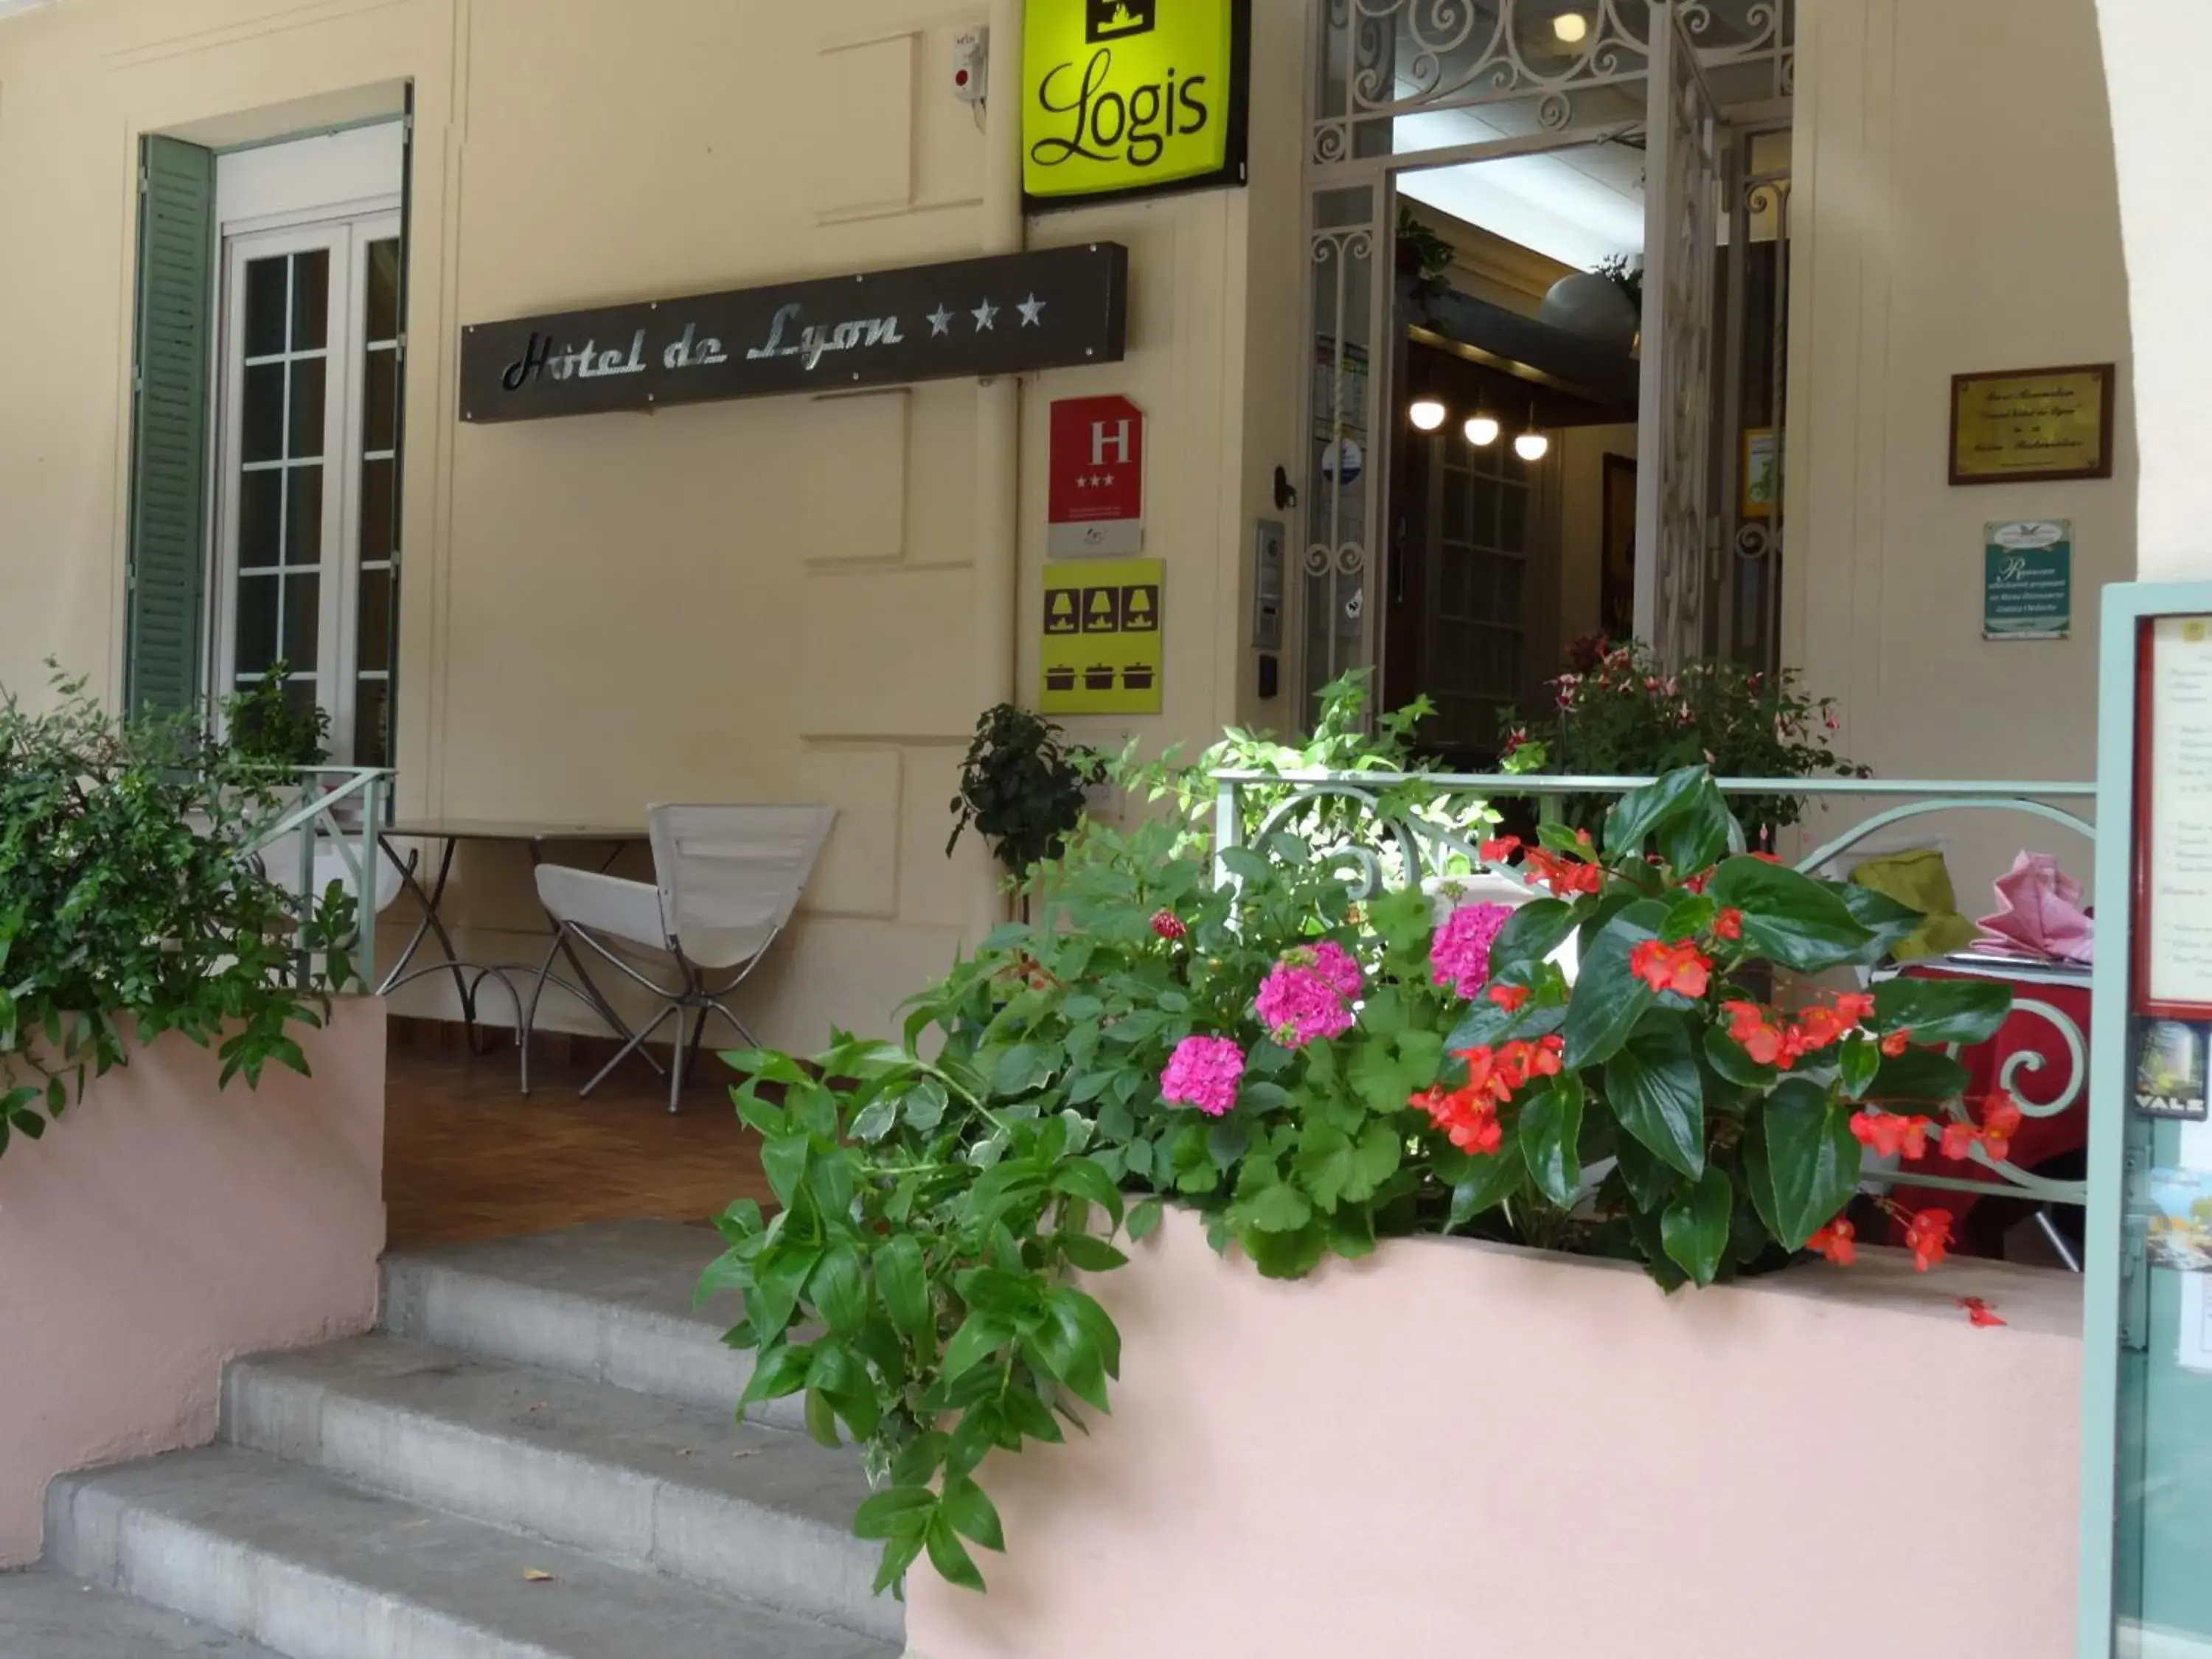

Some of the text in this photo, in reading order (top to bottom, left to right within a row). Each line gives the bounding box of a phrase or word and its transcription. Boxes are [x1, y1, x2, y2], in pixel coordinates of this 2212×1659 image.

[1031, 48, 1208, 167] Logis
[502, 302, 905, 392] Hôtel de Lyon
[1089, 420, 1132, 465] H
